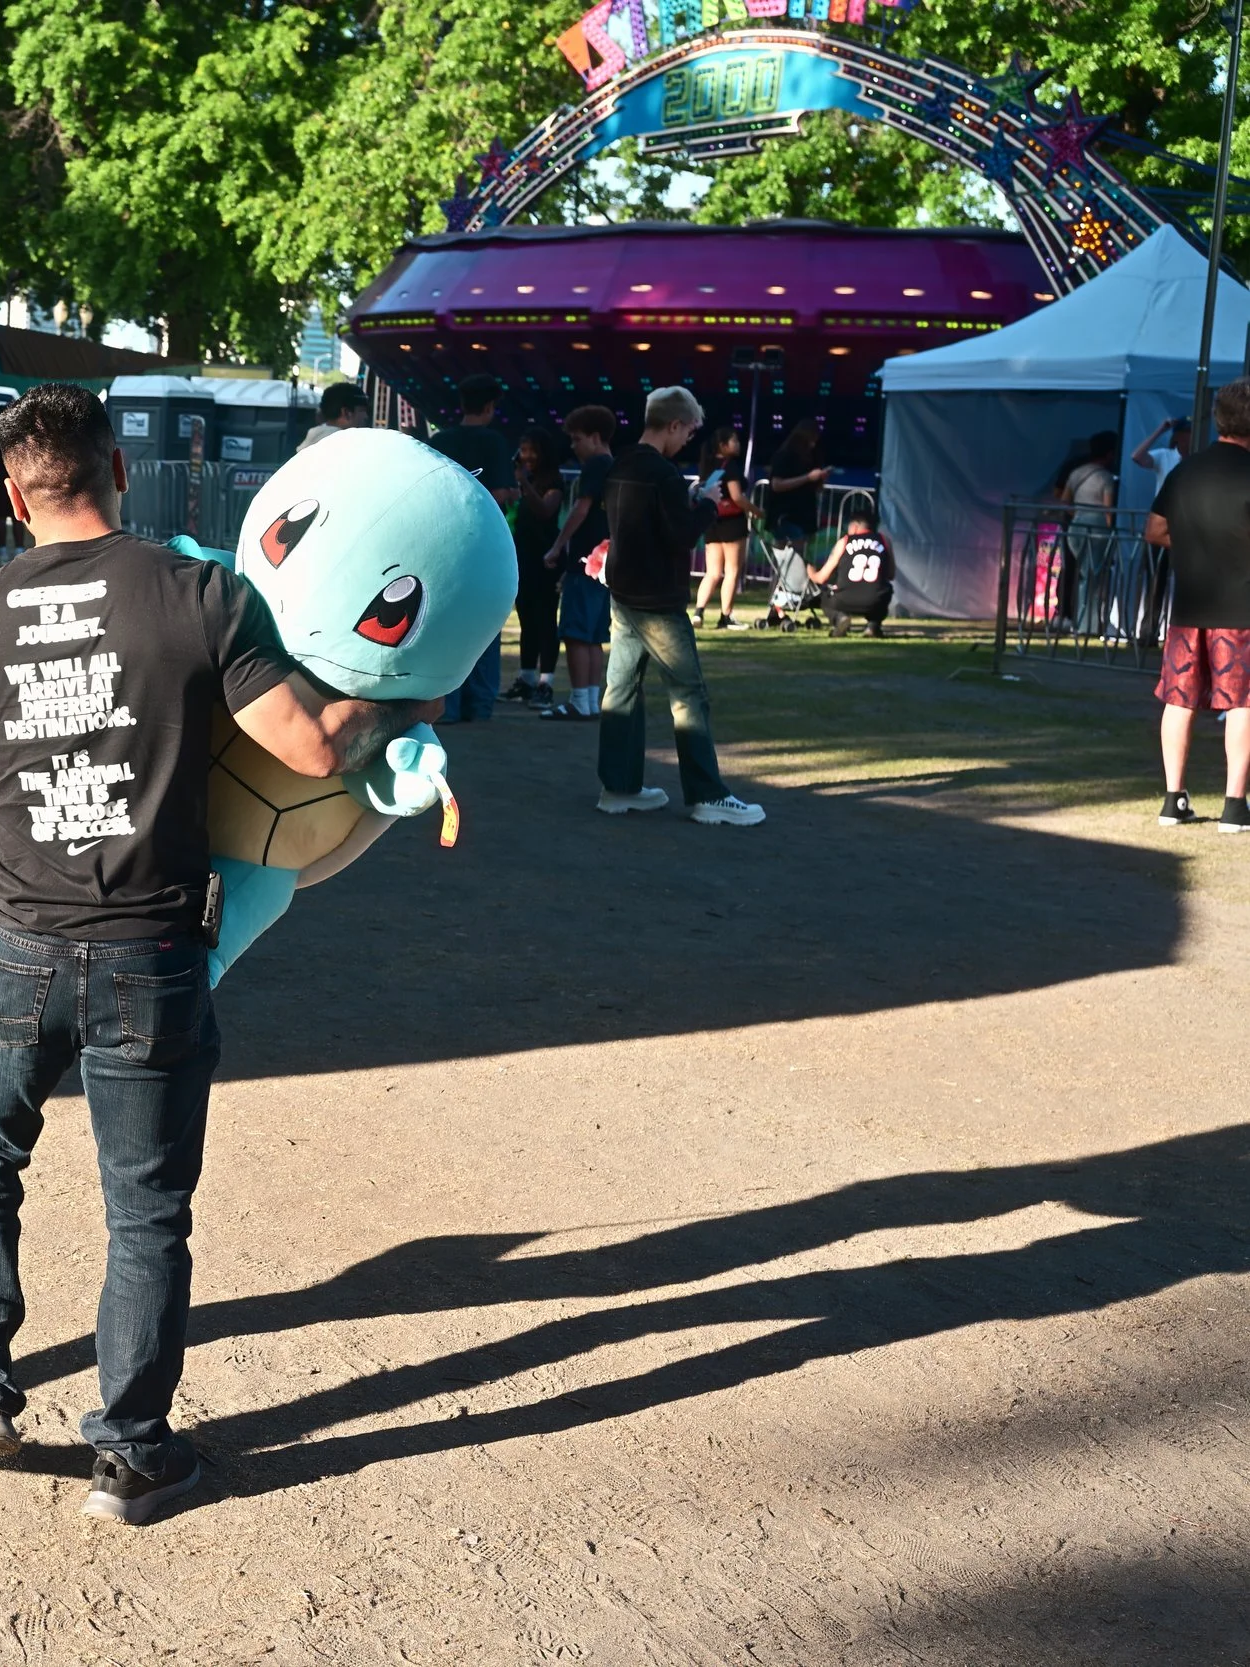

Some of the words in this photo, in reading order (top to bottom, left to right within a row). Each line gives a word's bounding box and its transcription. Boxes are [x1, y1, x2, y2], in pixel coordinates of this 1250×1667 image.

[662, 57, 782, 126] 2000
[847, 553, 881, 582] 33
[39, 604, 58, 624] IS
[61, 603, 77, 623] A
[16, 617, 106, 646] JOURNEY.
[4, 663, 37, 685] WE
[39, 657, 86, 681] WILL
[88, 652, 122, 676] ALL
[17, 677, 87, 702] ARRIVE
[90, 672, 114, 694] AT
[21, 691, 114, 720] DIFFERENT
[4, 706, 137, 741] DESTINATIONS.
[51, 754, 69, 770] IT
[73, 750, 91, 767] IS
[18, 771, 52, 791] THE
[56, 762, 135, 788] ARRIVAL
[41, 785, 89, 807] THAT
[91, 784, 109, 803] IS
[27, 805, 64, 823] THE
[65, 798, 129, 822] PROOF
[31, 821, 57, 842] OF
